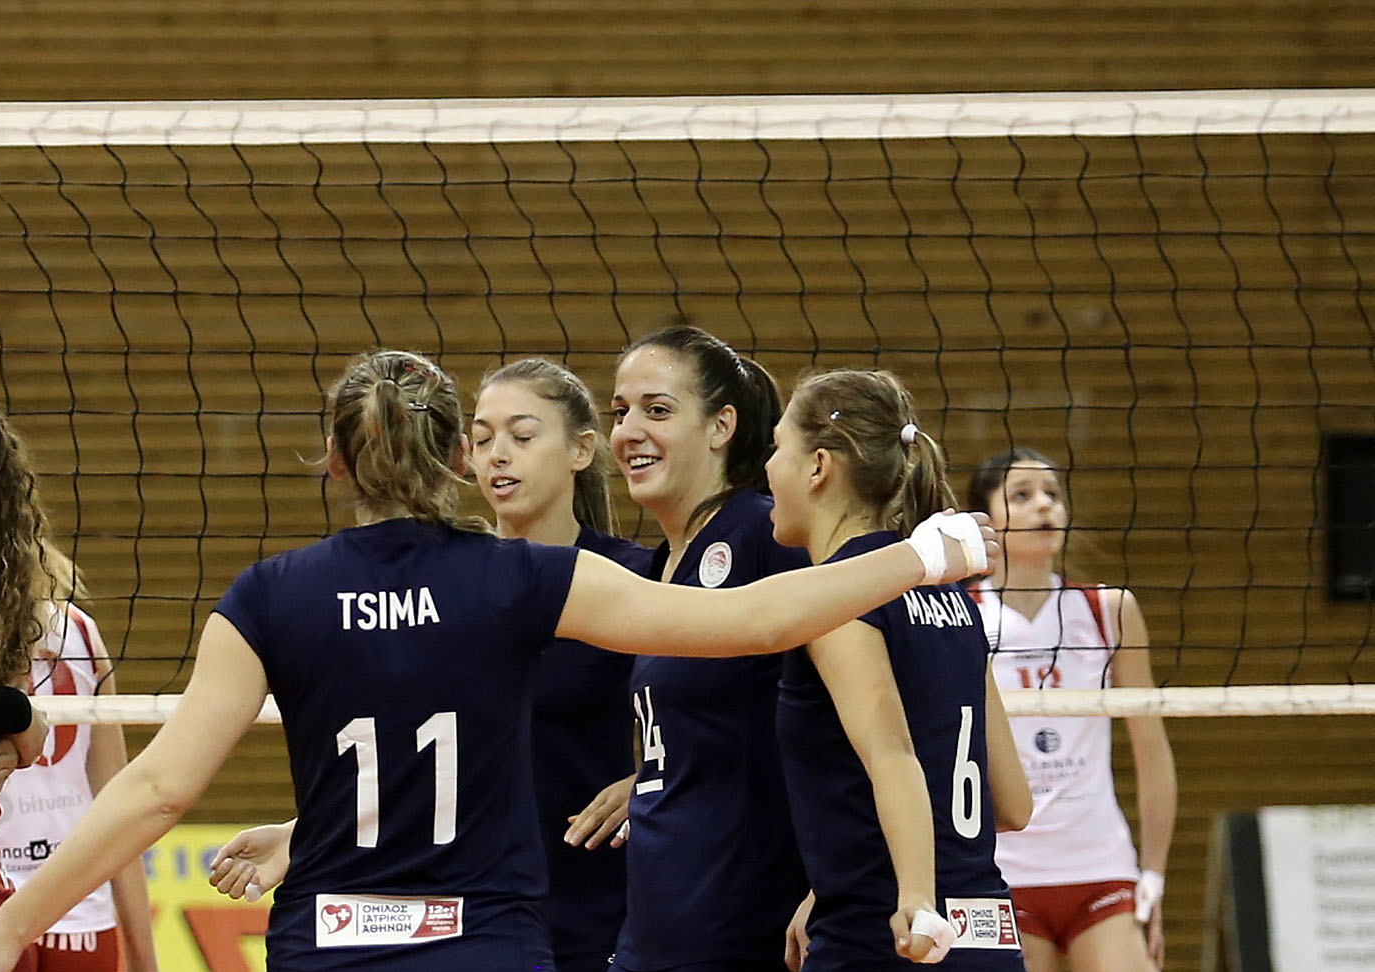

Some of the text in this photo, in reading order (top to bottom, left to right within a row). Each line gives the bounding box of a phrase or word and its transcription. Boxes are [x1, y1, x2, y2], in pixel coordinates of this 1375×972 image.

[336, 586, 441, 631] TSIMA
[335, 710, 459, 848] 11
[950, 705, 982, 839] 6
[362, 904, 409, 914] ΟΜΙΛΟΣ
[362, 914, 413, 923] ΙΑΤΡΙΚΟΥ
[362, 923, 413, 934] ΑΘΗΝΩΝ
